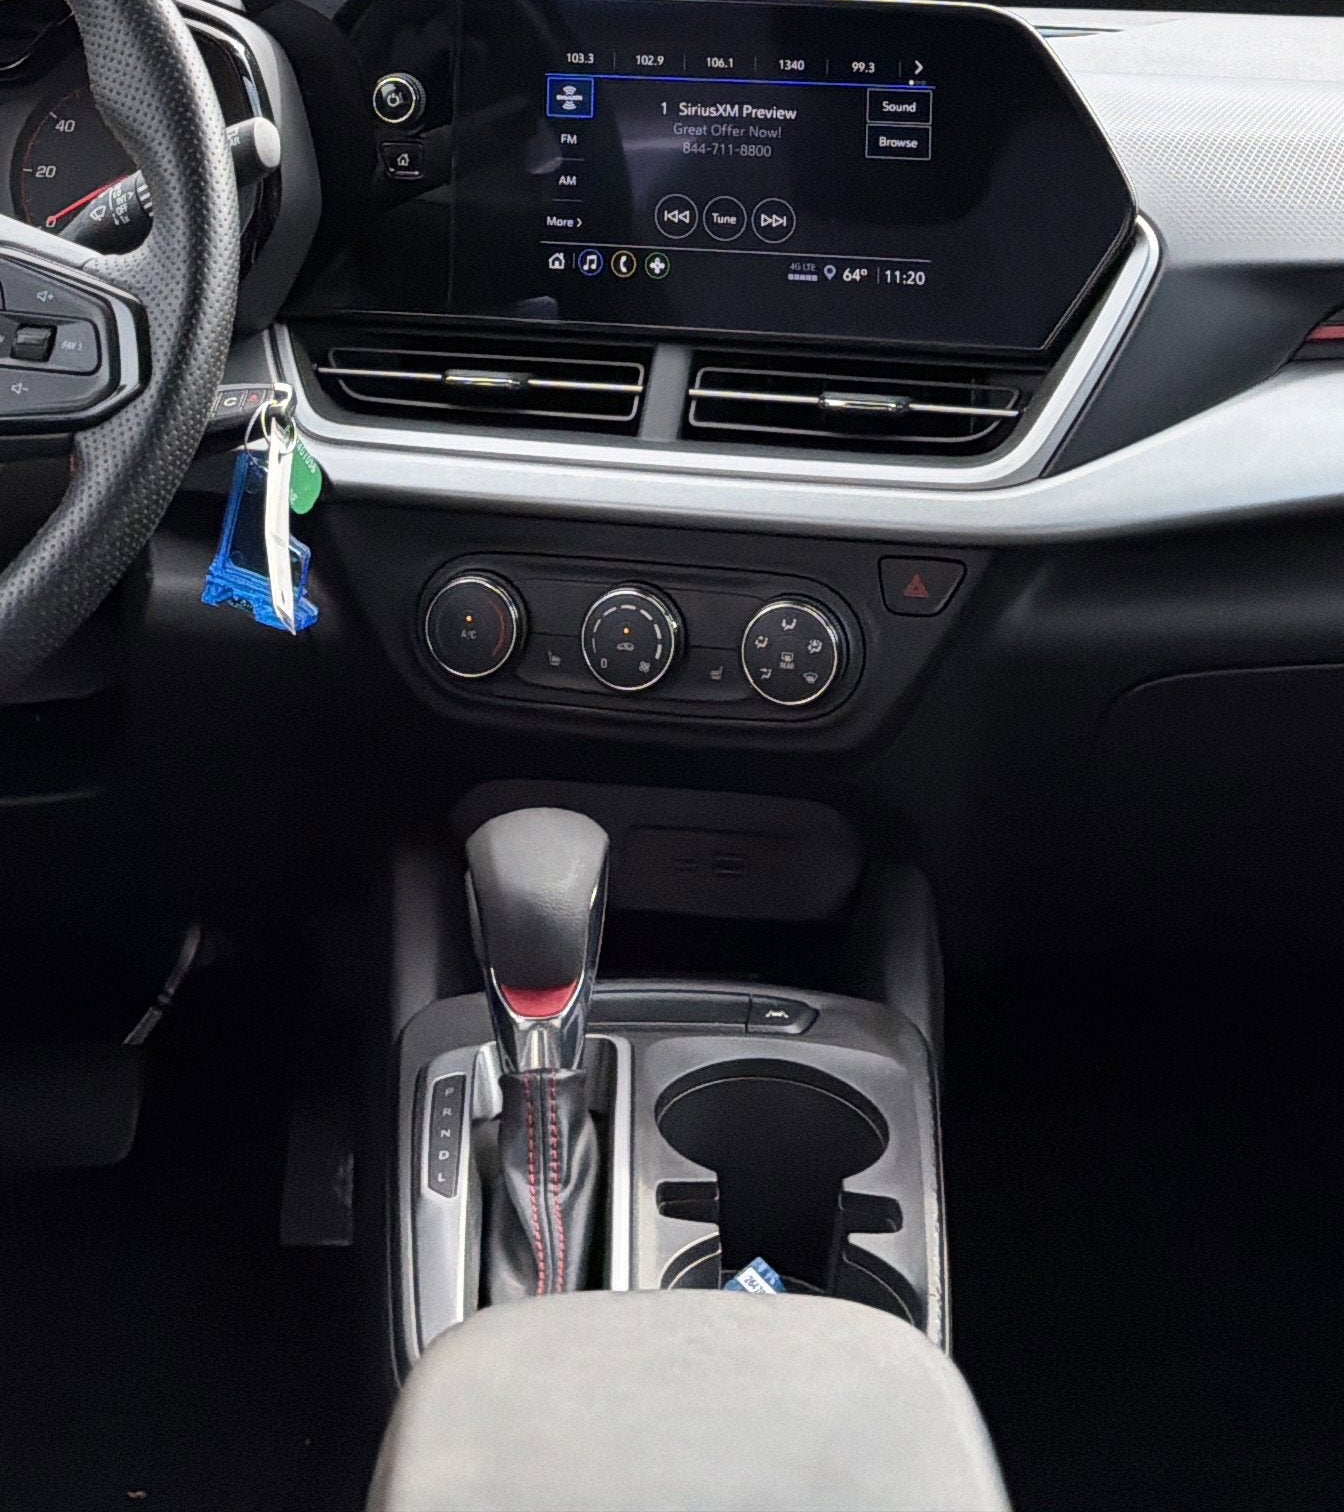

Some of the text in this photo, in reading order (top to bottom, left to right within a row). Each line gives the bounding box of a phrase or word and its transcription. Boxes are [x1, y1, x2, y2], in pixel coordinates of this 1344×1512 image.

[566, 53, 875, 73] 103.3 102.9 106.1 1340 99.3
[660, 101, 797, 120] 1 SiriusXM Preview
[881, 101, 917, 114] Sound
[55, 119, 75, 132] 40
[673, 123, 782, 138] Great Offer Now!
[560, 134, 577, 144] FM
[878, 136, 918, 149] Browse
[682, 141, 772, 157] 844-711-8800
[35, 166, 56, 178] 20
[558, 176, 576, 186] AM
[546, 216, 574, 227] More
[711, 213, 737, 225] Tune
[885, 270, 926, 285] 11:20
[600, 657, 608, 669] 0
[444, 1087, 455, 1096] P
[442, 1108, 453, 1117] R
[440, 1129, 451, 1138] N
[438, 1149, 450, 1160] D
[437, 1172, 446, 1183] L
